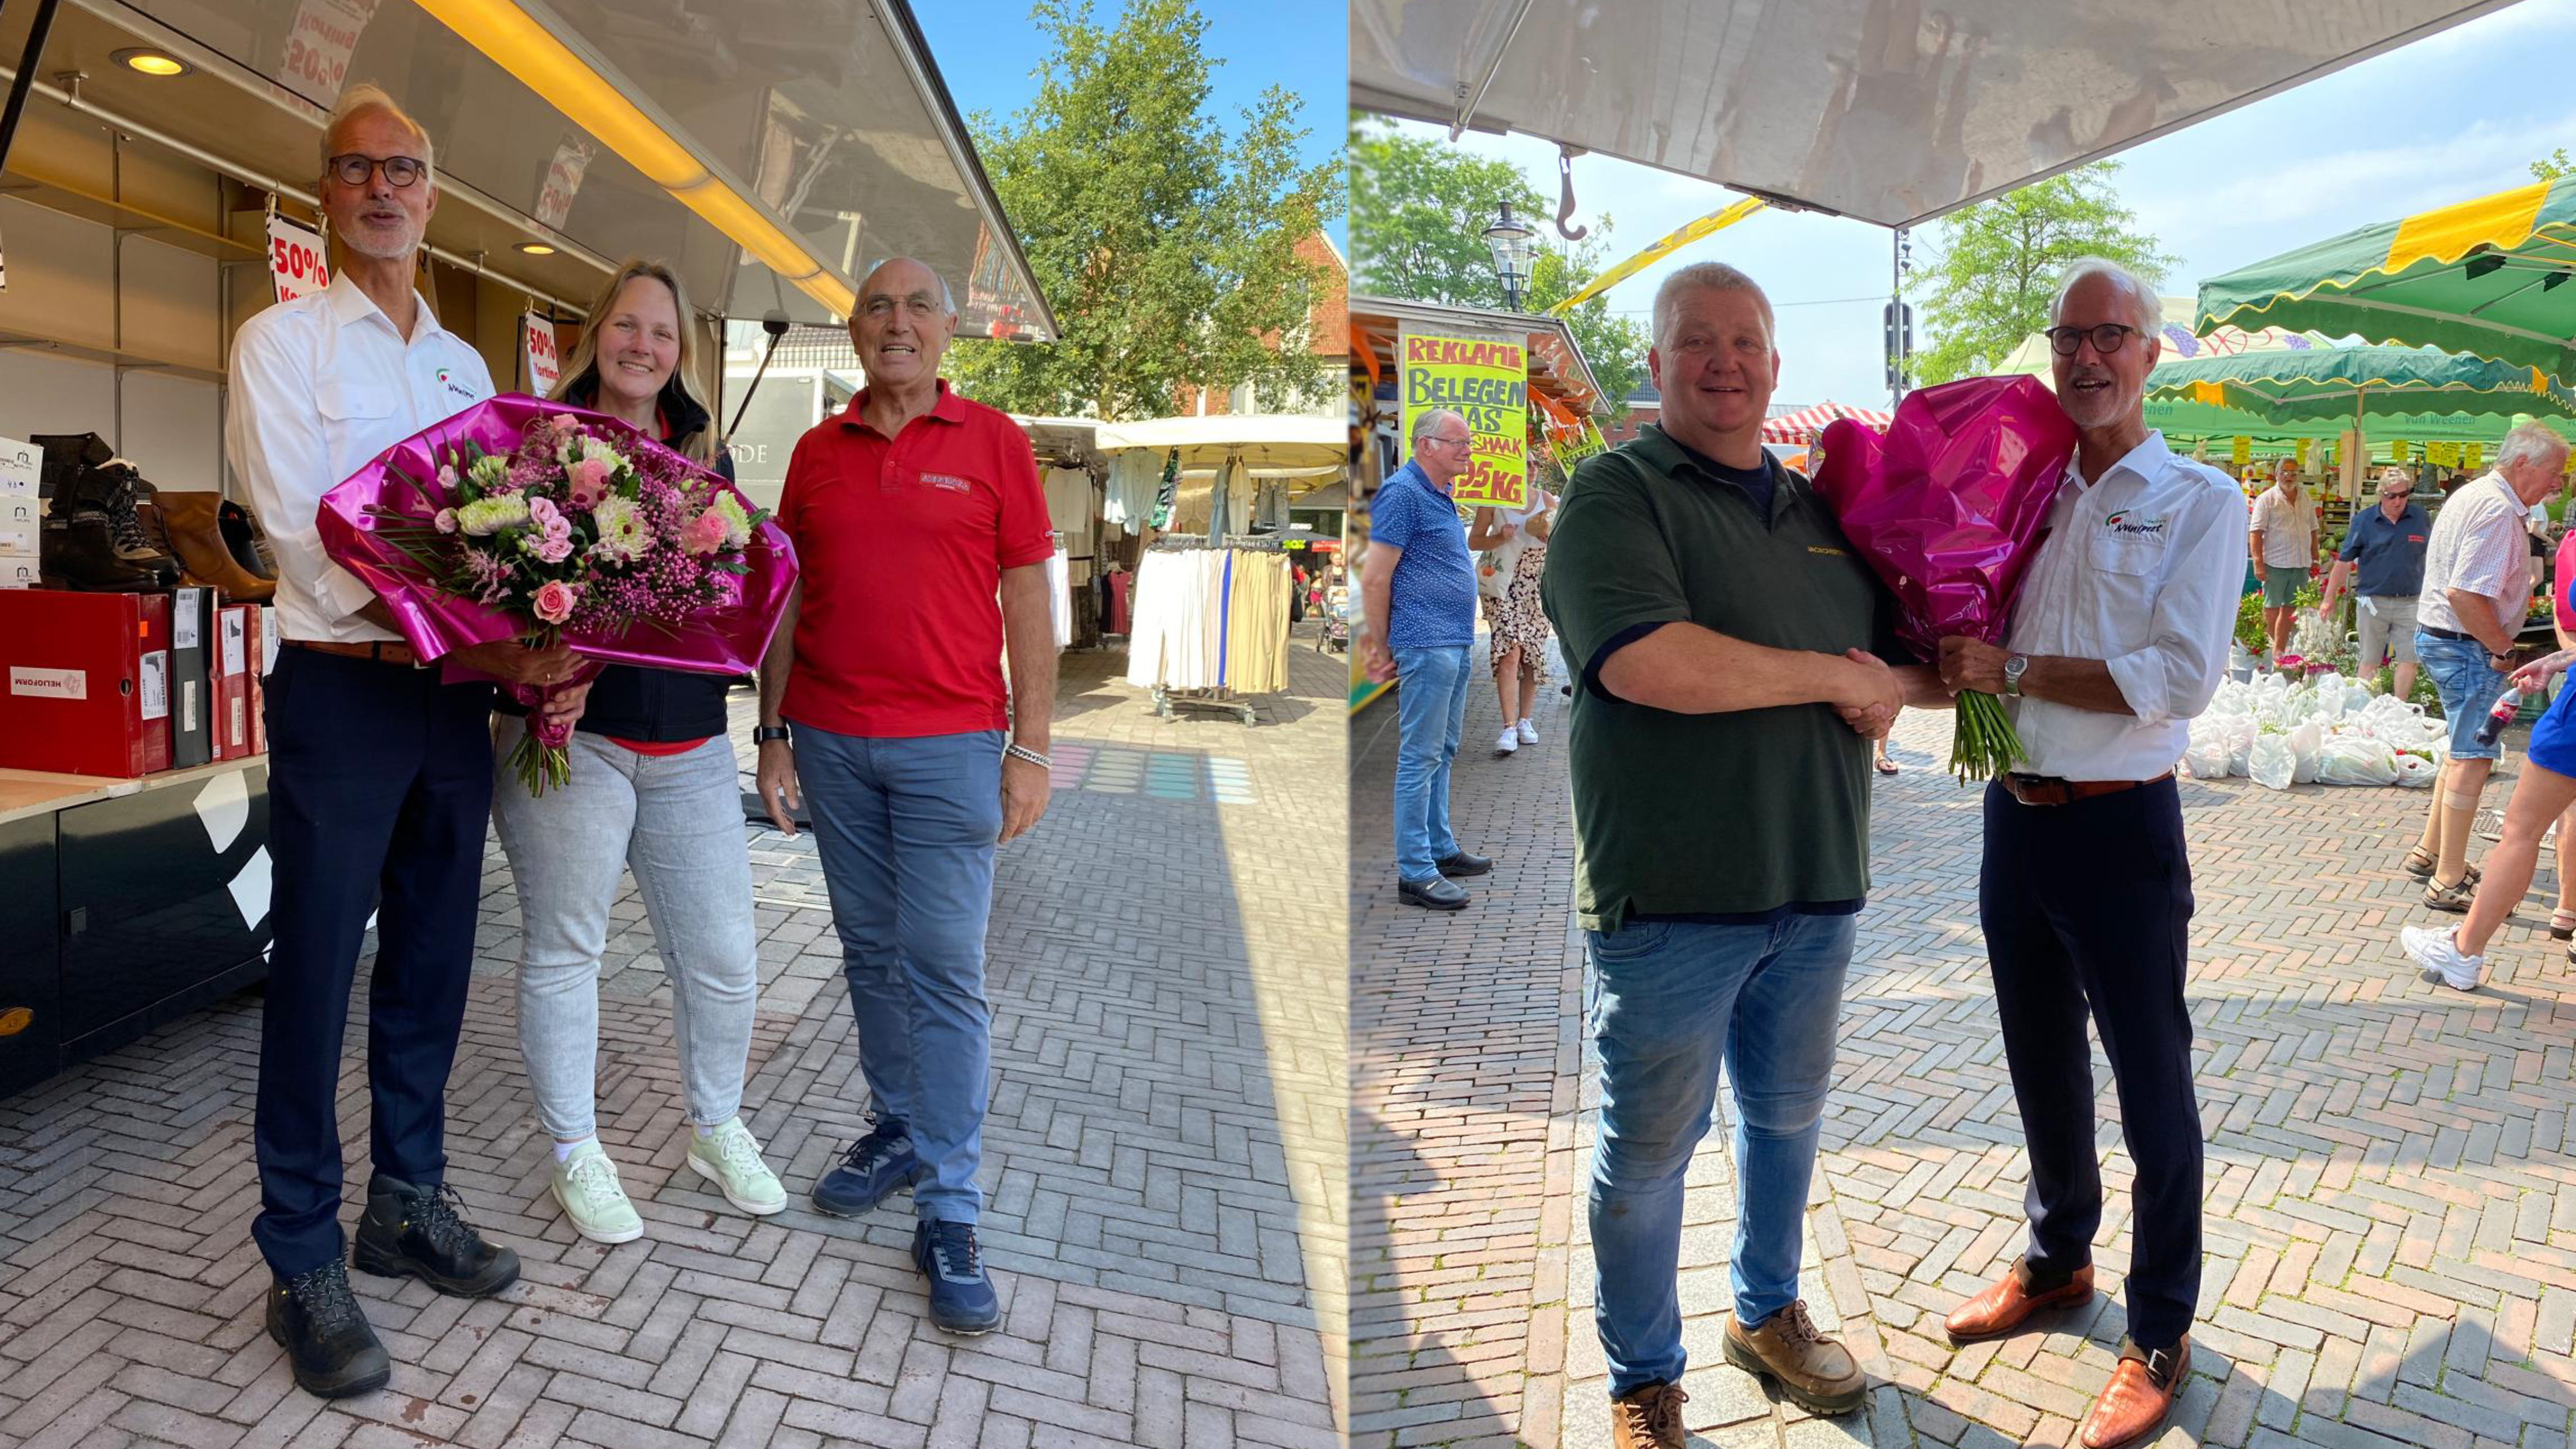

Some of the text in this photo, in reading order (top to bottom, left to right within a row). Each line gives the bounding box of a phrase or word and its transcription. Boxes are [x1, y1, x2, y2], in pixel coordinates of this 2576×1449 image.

[274, 237, 328, 288] 50%
[530, 327, 558, 360] 50%
[1408, 338, 1522, 368] REKLAME
[1408, 368, 1527, 407] BELEGEN
[1491, 470, 1523, 502] KG
[2114, 524, 2163, 535] Nunspeet
[15, 678, 61, 687] HELIOFORM
